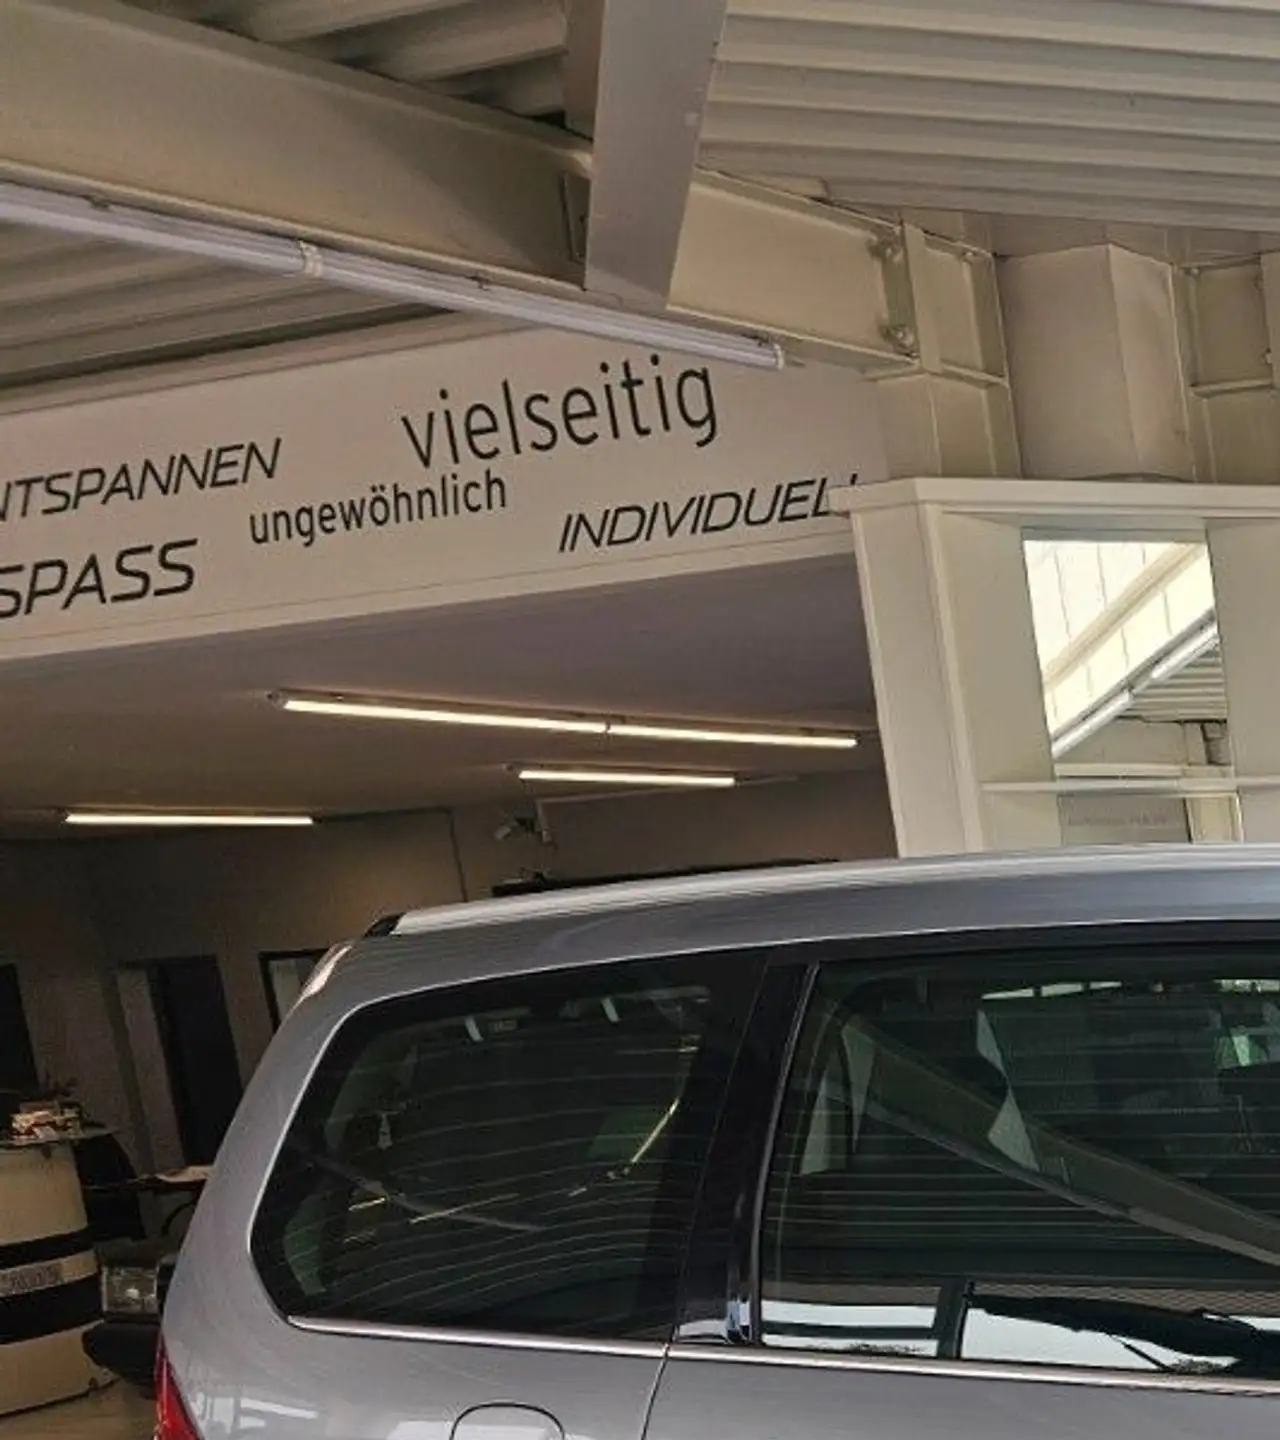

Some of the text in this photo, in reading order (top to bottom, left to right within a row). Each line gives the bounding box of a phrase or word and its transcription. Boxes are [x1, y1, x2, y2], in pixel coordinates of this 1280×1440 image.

[401, 354, 718, 470] vielseitig
[249, 468, 507, 548] ungewöhnlich
[558, 473, 859, 554] INDIVIDUEL
